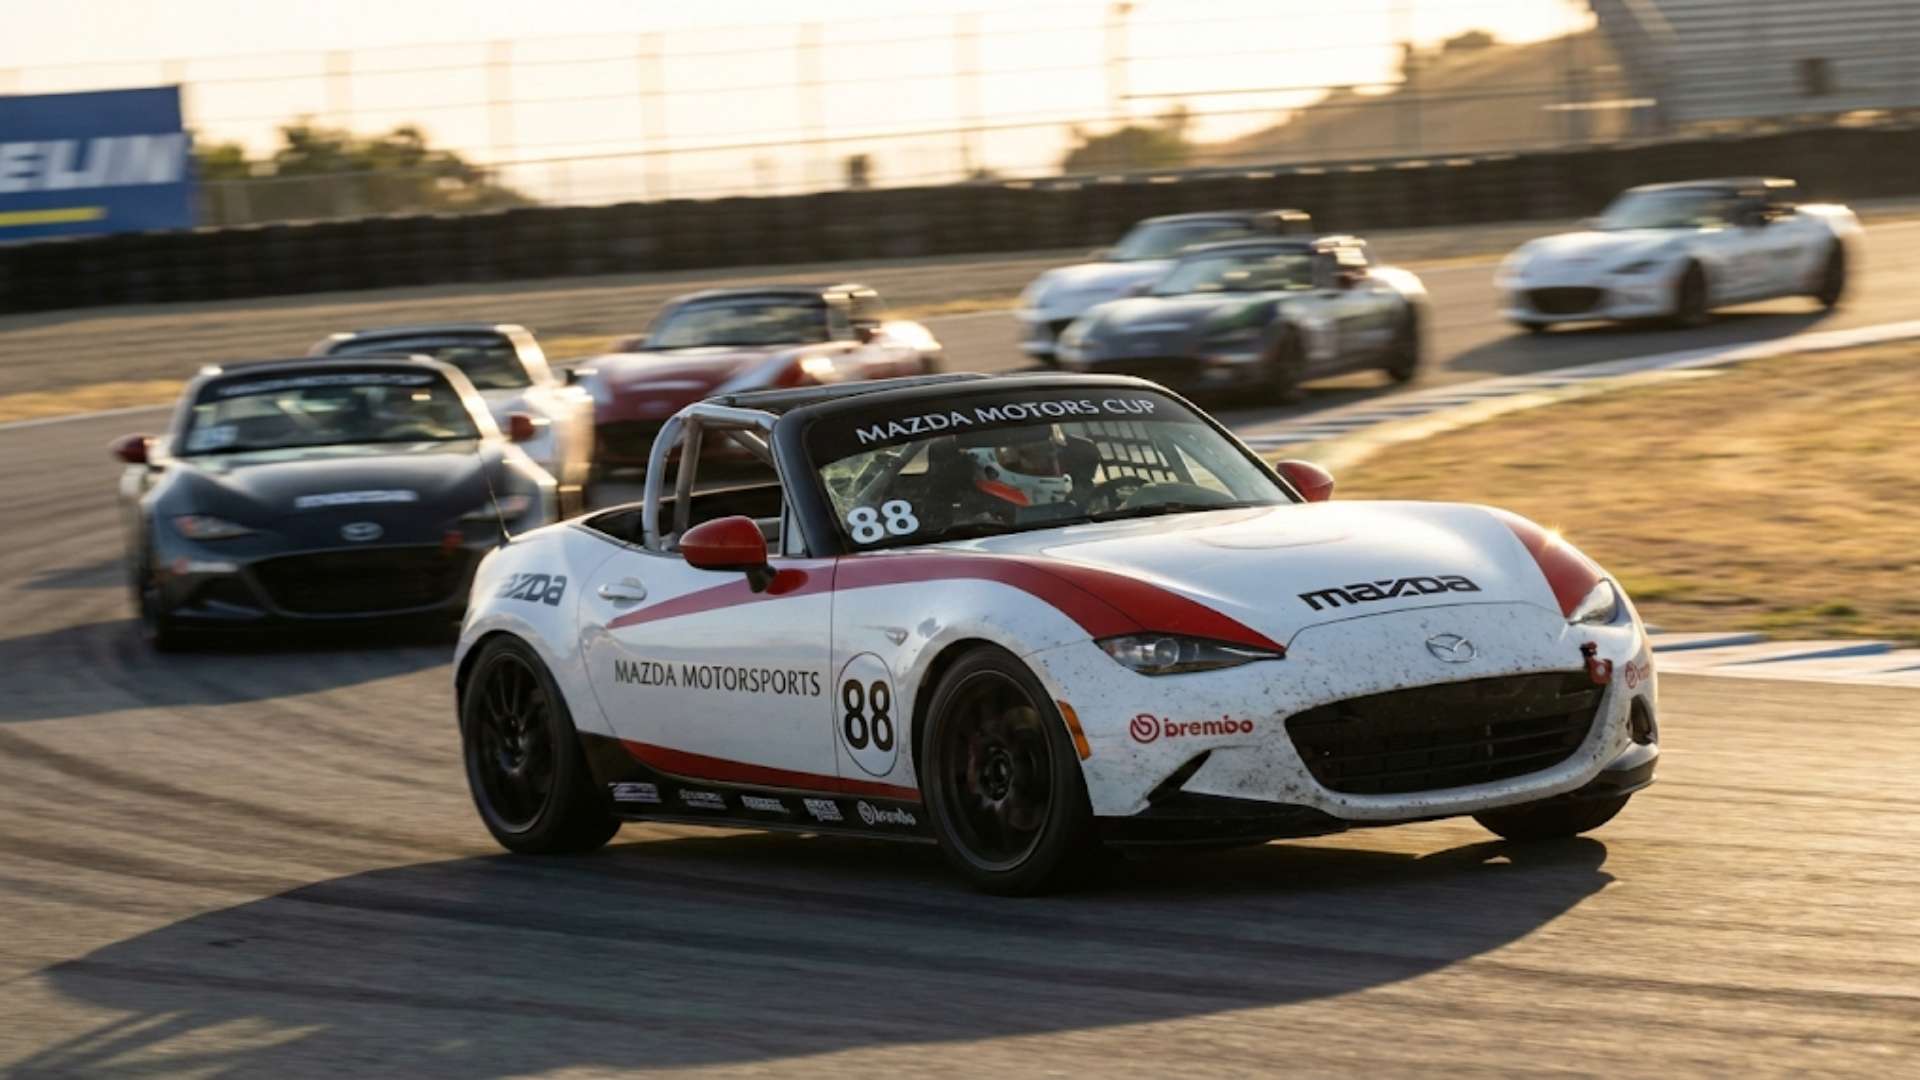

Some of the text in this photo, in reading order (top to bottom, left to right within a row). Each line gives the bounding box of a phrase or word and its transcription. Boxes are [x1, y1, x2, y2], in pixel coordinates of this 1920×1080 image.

[856, 398, 1155, 445] MAZDA MOTORS CUP
[846, 499, 919, 545] 88
[614, 659, 821, 697] MAZDA MOTORSPORTS
[842, 679, 894, 752] 88
[1164, 714, 1255, 738] brembo
